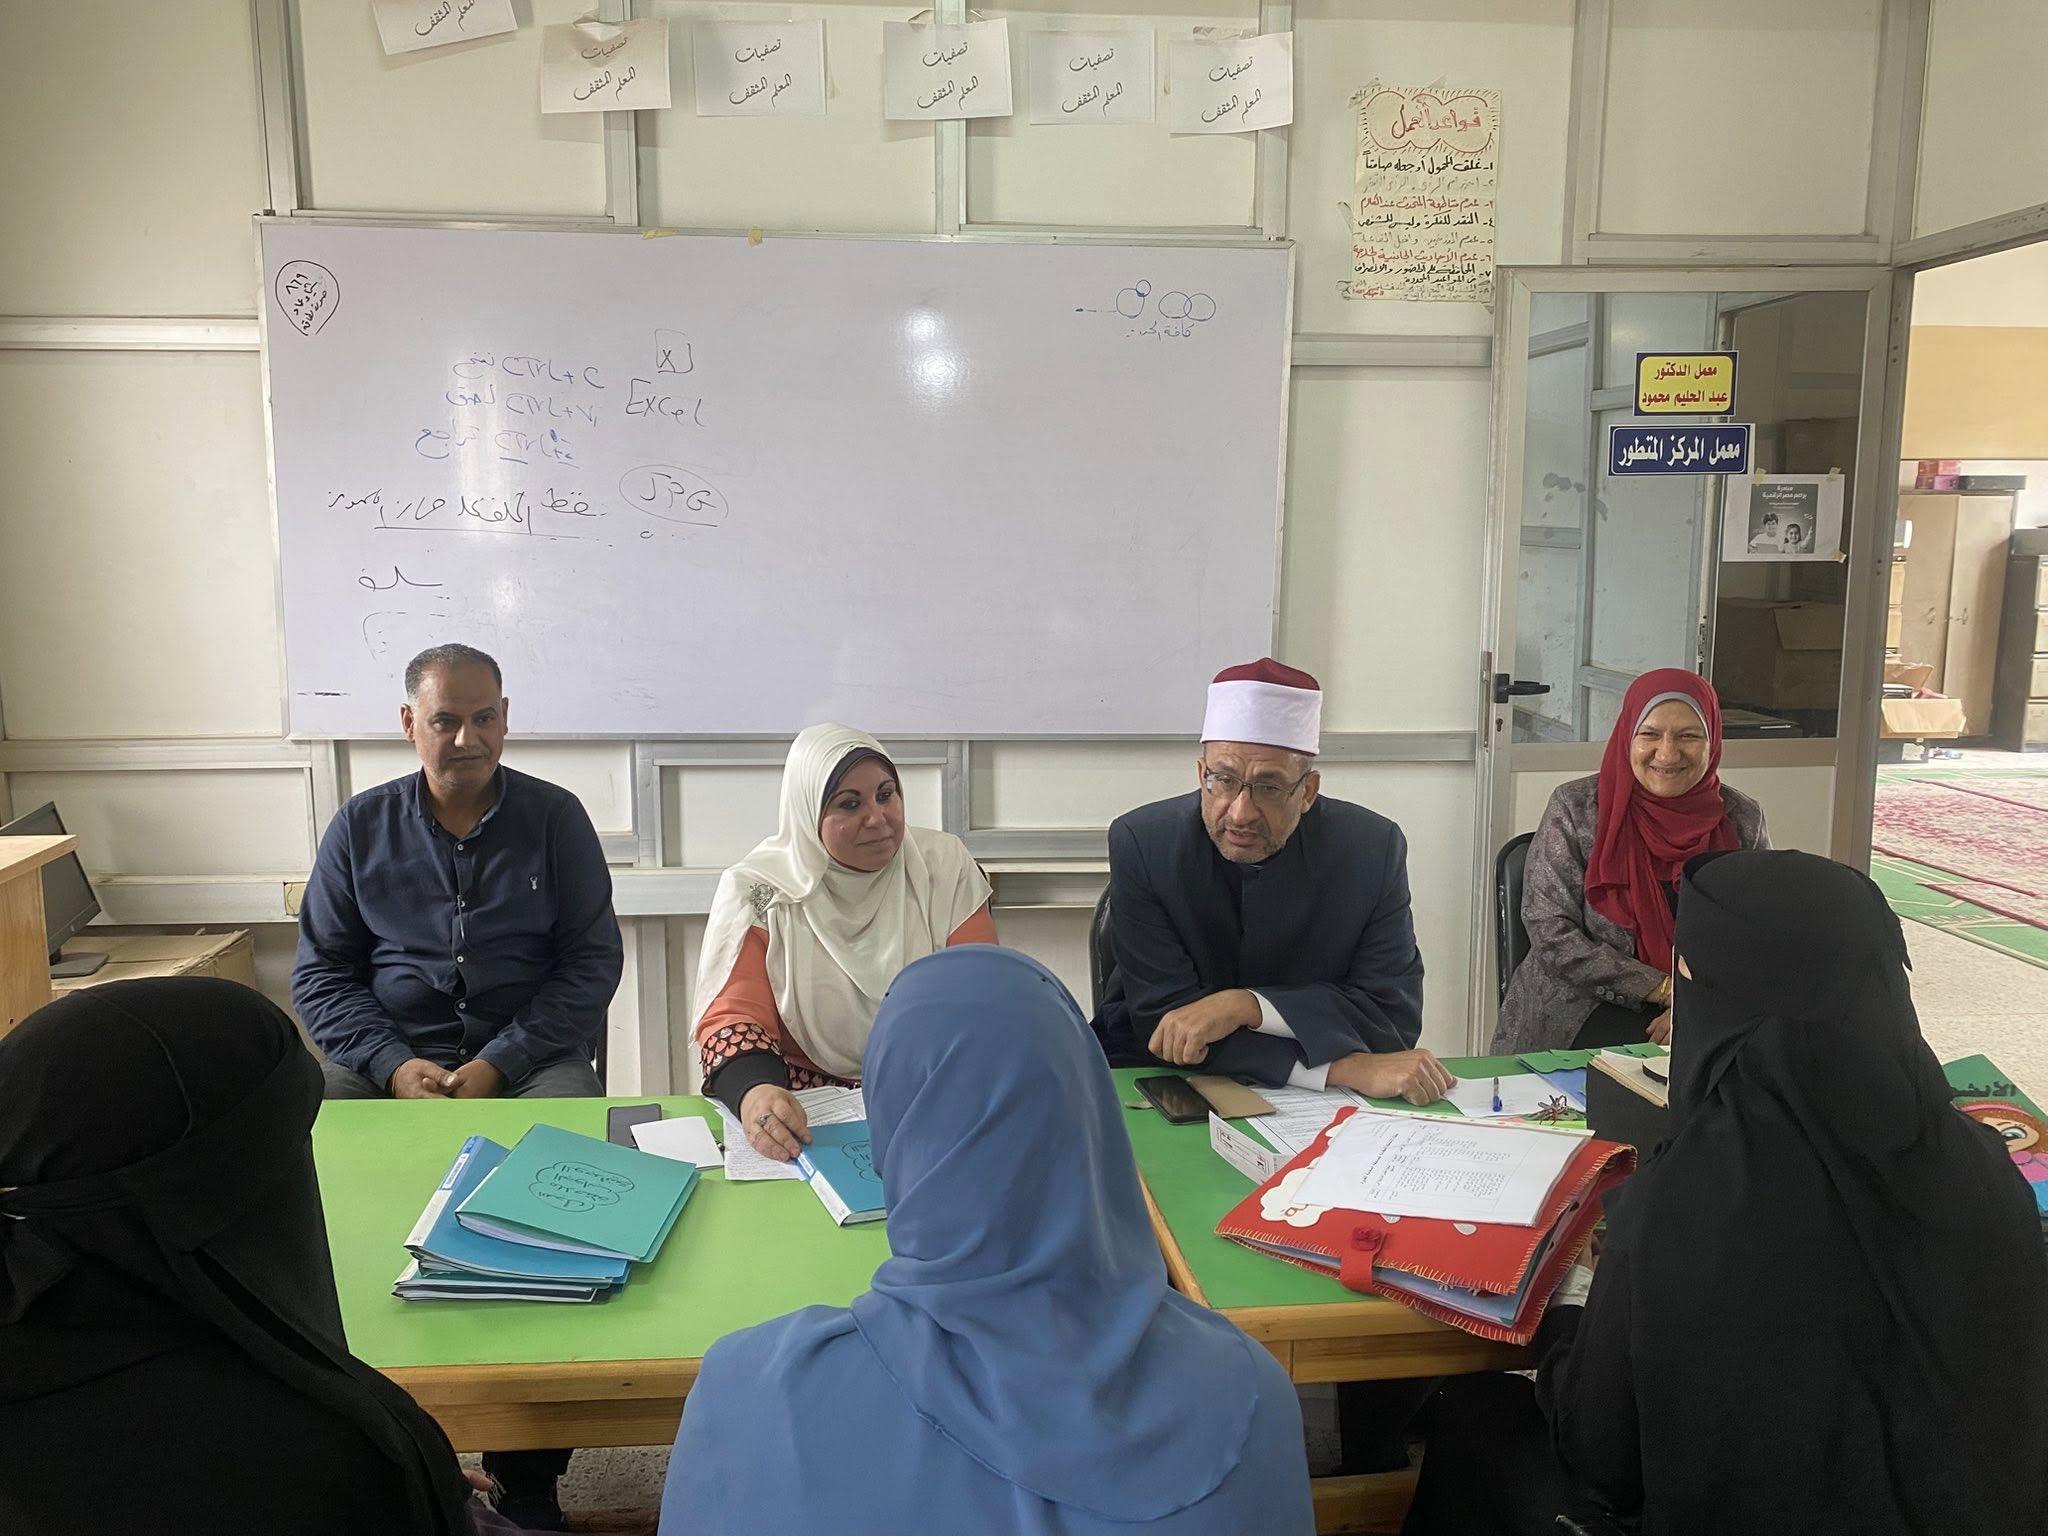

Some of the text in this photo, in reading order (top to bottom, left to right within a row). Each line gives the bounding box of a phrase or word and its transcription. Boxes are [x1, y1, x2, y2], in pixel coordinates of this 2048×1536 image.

[414, 0, 452, 36] المثقف
[581, 37, 628, 60] تصفيات
[735, 38, 782, 63] تصفيات
[923, 41, 968, 68] تصفيات
[1069, 48, 1114, 73] تصفيات
[1208, 56, 1254, 83] تصفيات
[573, 66, 637, 102] المعلم المثقف
[728, 73, 792, 108] المعلم المثقف
[917, 75, 979, 110] المعلم المثقف
[1062, 82, 1124, 116] المعلم المثقف
[1200, 89, 1262, 124] المعلم المثقف
[1460, 199, 1479, 213] عدم
[1655, 361, 1718, 380] معمل الدكتور
[1641, 390, 1728, 407] عبد الحليم محمود
[1618, 434, 1741, 467] معمل المركز المتطور
